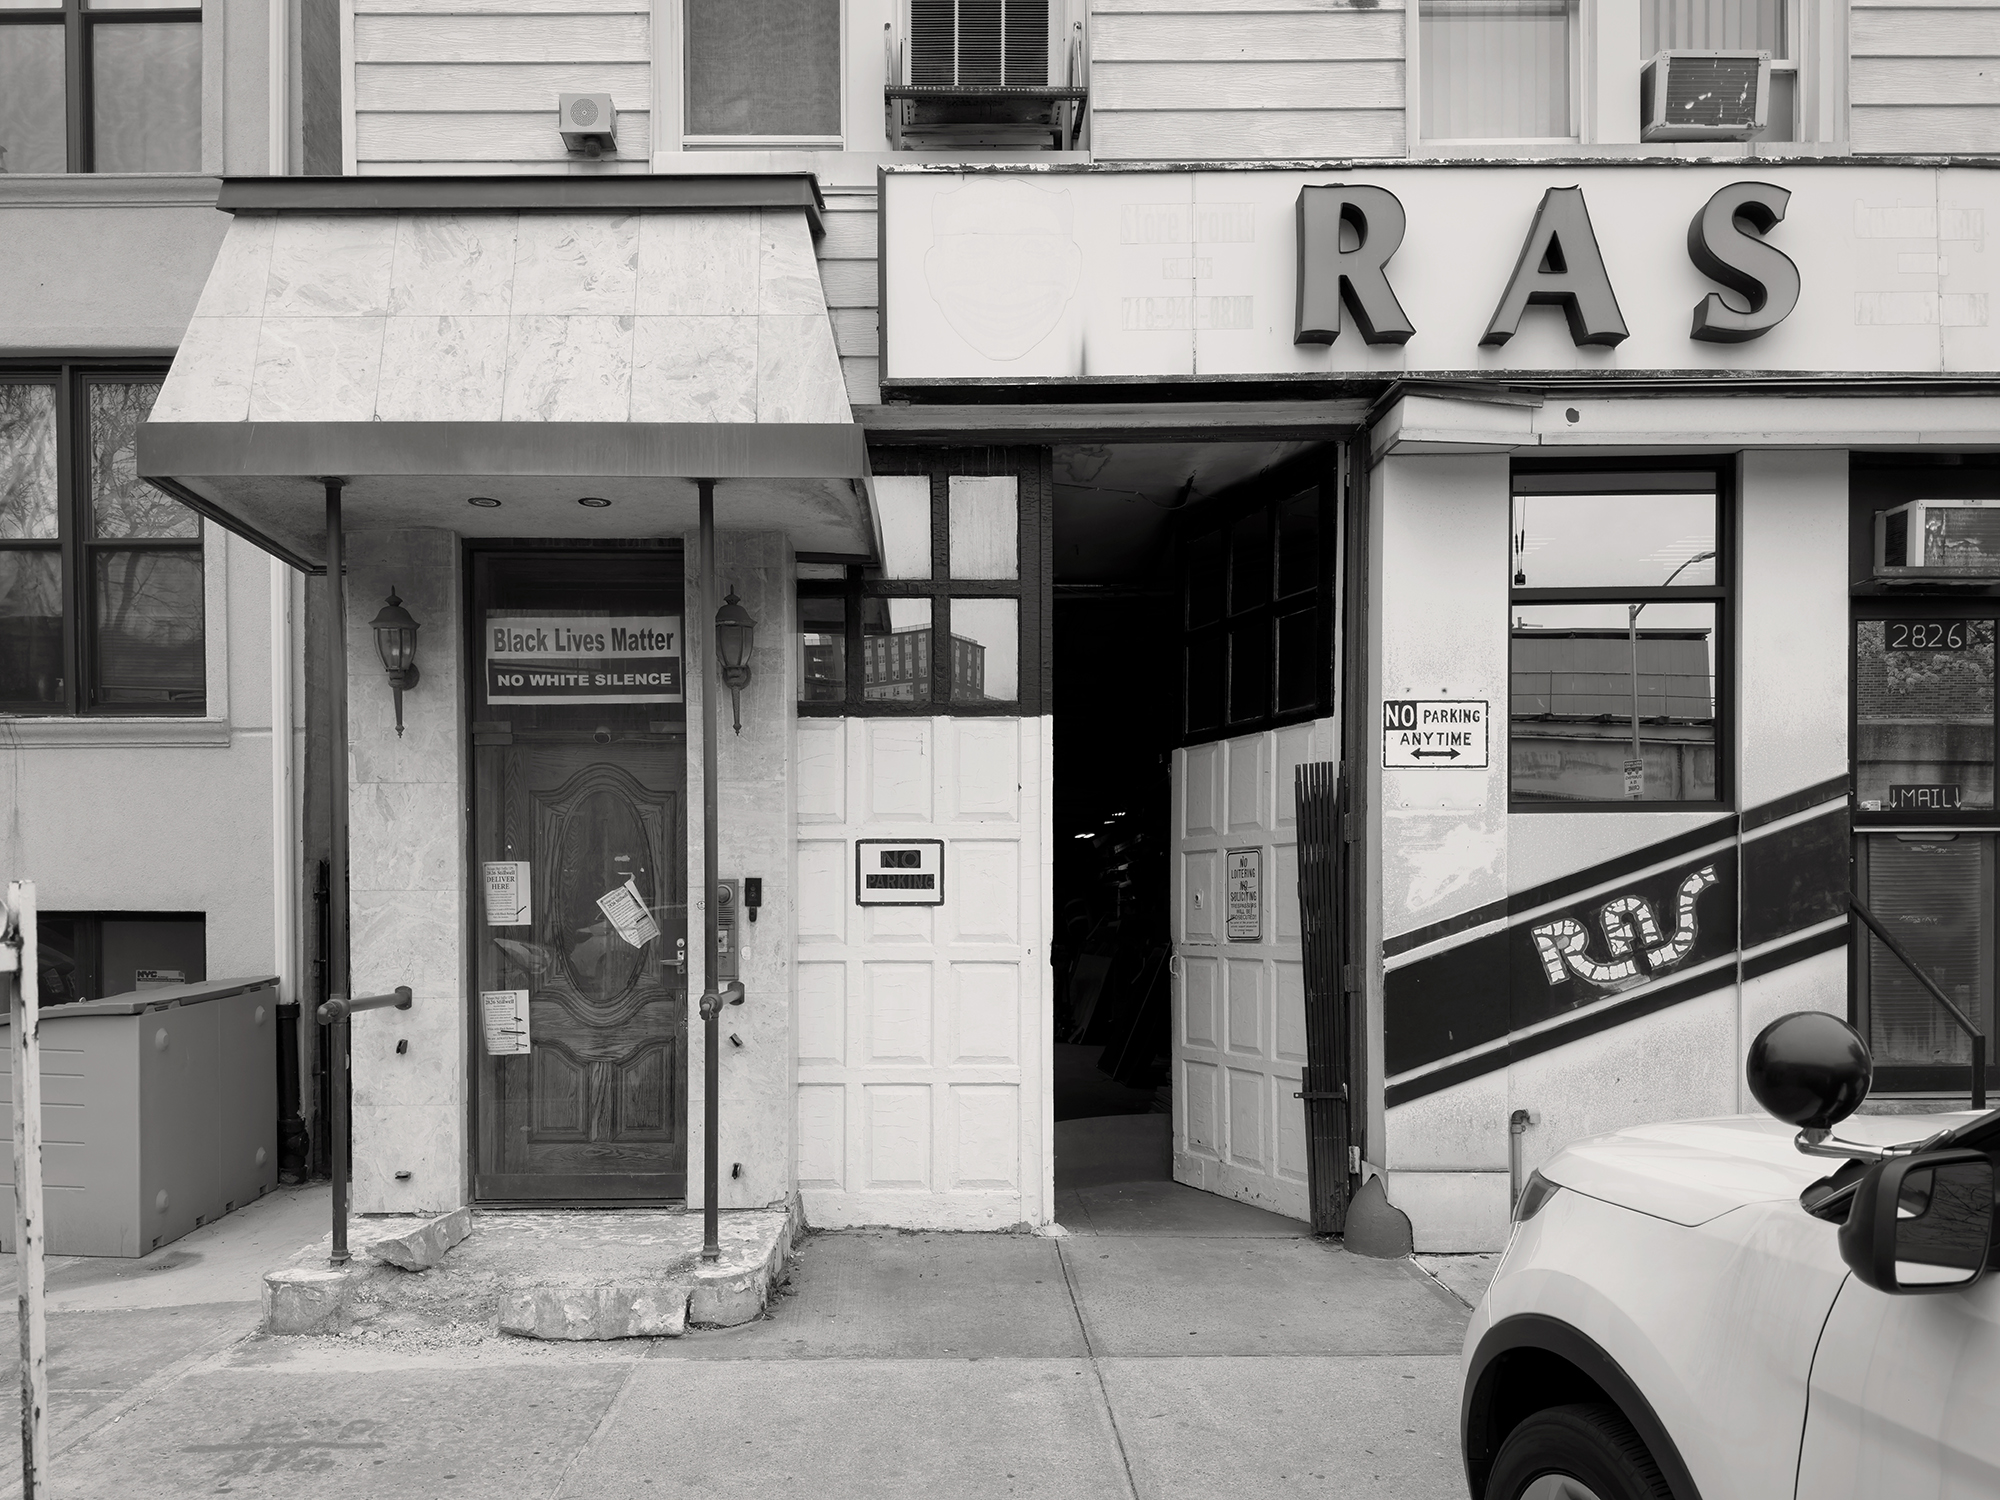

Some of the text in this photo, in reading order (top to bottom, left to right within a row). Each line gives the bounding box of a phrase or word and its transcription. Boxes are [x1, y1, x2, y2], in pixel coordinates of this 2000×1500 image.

[1186, 258, 1213, 279] 175
[1294, 180, 1801, 347] RAS
[493, 627, 674, 652] Black Lives Matter
[1892, 623, 1962, 649] 2826
[497, 673, 672, 687] NO WHITE SILENCE
[1385, 703, 1480, 727] NO PARKING
[1399, 731, 1472, 746] ANYTIME
[1901, 789, 1952, 809] MAIL
[882, 851, 920, 868] NO
[1240, 857, 1248, 867] NO
[1230, 868, 1256, 879] LOITERING
[867, 875, 934, 889] PARKING
[1240, 880, 1248, 891] NO
[1230, 891, 1257, 902] SOLICITING
[1531, 864, 1719, 985] RAS
[137, 970, 157, 978] NYC
